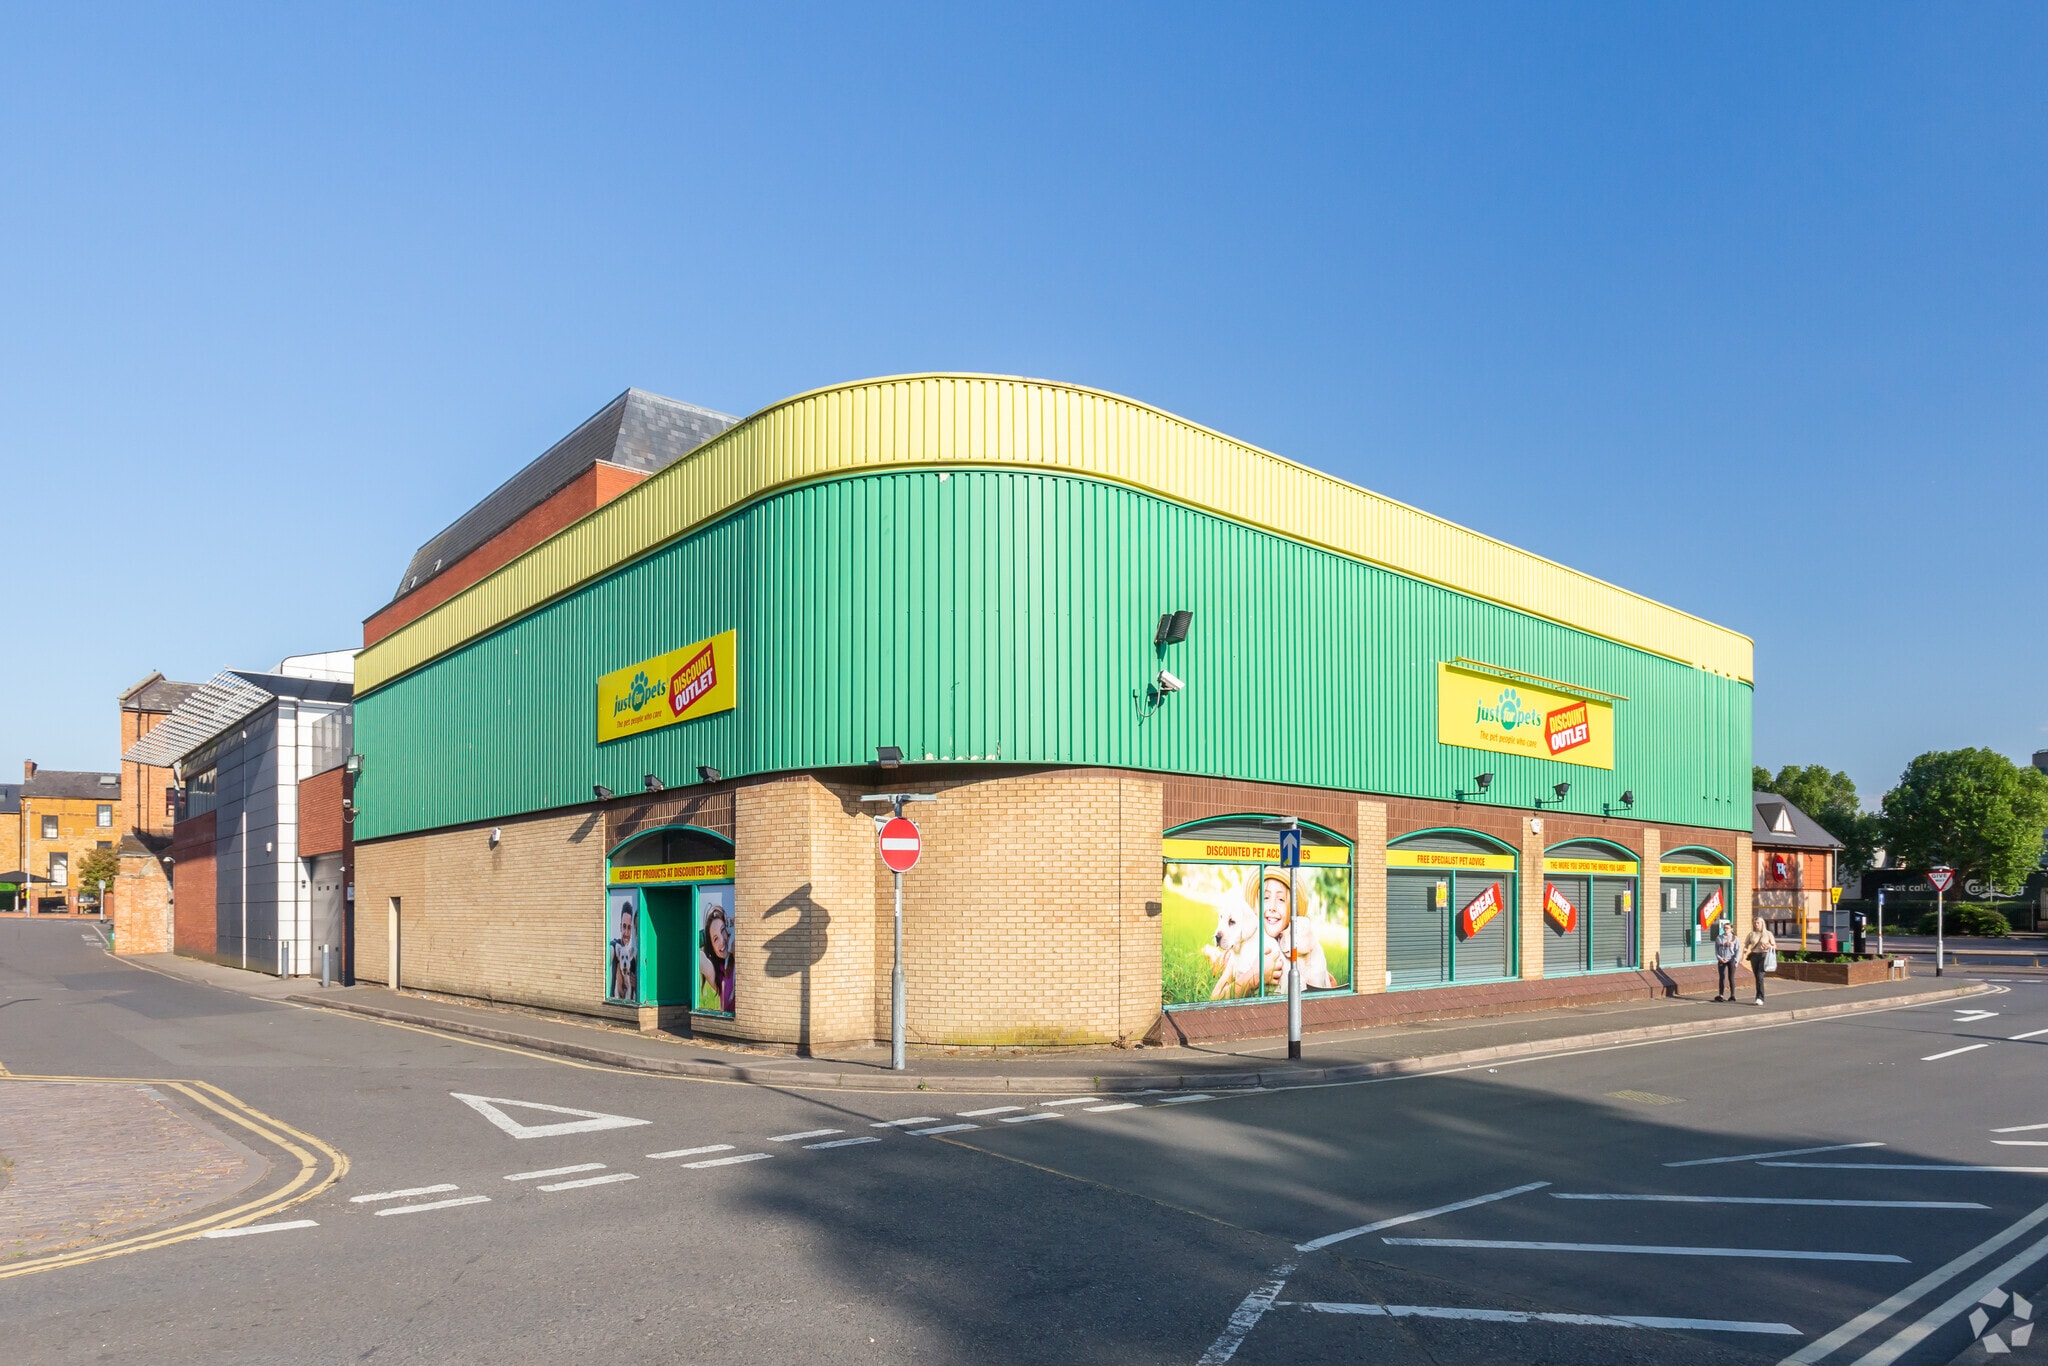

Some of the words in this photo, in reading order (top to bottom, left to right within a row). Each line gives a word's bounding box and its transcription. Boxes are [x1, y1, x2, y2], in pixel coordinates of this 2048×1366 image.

[673, 650, 711, 696] DISCOUNT
[613, 694, 631, 718] just
[644, 679, 666, 705] pets
[675, 667, 713, 711] OUTLET
[630, 715, 643, 726] people
[653, 710, 662, 719] care
[1475, 699, 1500, 724] just
[1517, 708, 1541, 728] pets
[1549, 706, 1586, 734] DISCOUNT
[1480, 730, 1489, 740] The
[1489, 733, 1498, 742] pet
[1499, 735, 1515, 745] people
[1516, 737, 1526, 746] who
[1527, 739, 1538, 748] care
[1551, 723, 1588, 751] OUTLET
[1206, 845, 1250, 857] DISCOUNTED
[1252, 847, 1265, 858] PET
[1417, 854, 1430, 864] FREE
[1431, 855, 1458, 865] SPECIALIST
[1459, 856, 1468, 866] PET
[1468, 857, 1486, 867] ADVICE
[619, 870, 632, 880] GREAT
[633, 869, 642, 880] PET
[642, 868, 667, 879] PRODUCTS
[667, 868, 673, 878] AT
[673, 866, 705, 877] DISCOUNTED
[706, 864, 728, 876] PRICES!
[1550, 861, 1558, 870] THE
[1558, 861, 1570, 870] MORE
[1578, 862, 1590, 870] SPEND
[1598, 863, 1608, 872] MORE
[1469, 887, 1495, 922] GREAT
[1547, 899, 1569, 927] PRICES
[1550, 887, 1571, 916] LOWER
[1703, 891, 1720, 920] GREAT
[1472, 902, 1498, 933] SAVINGS
